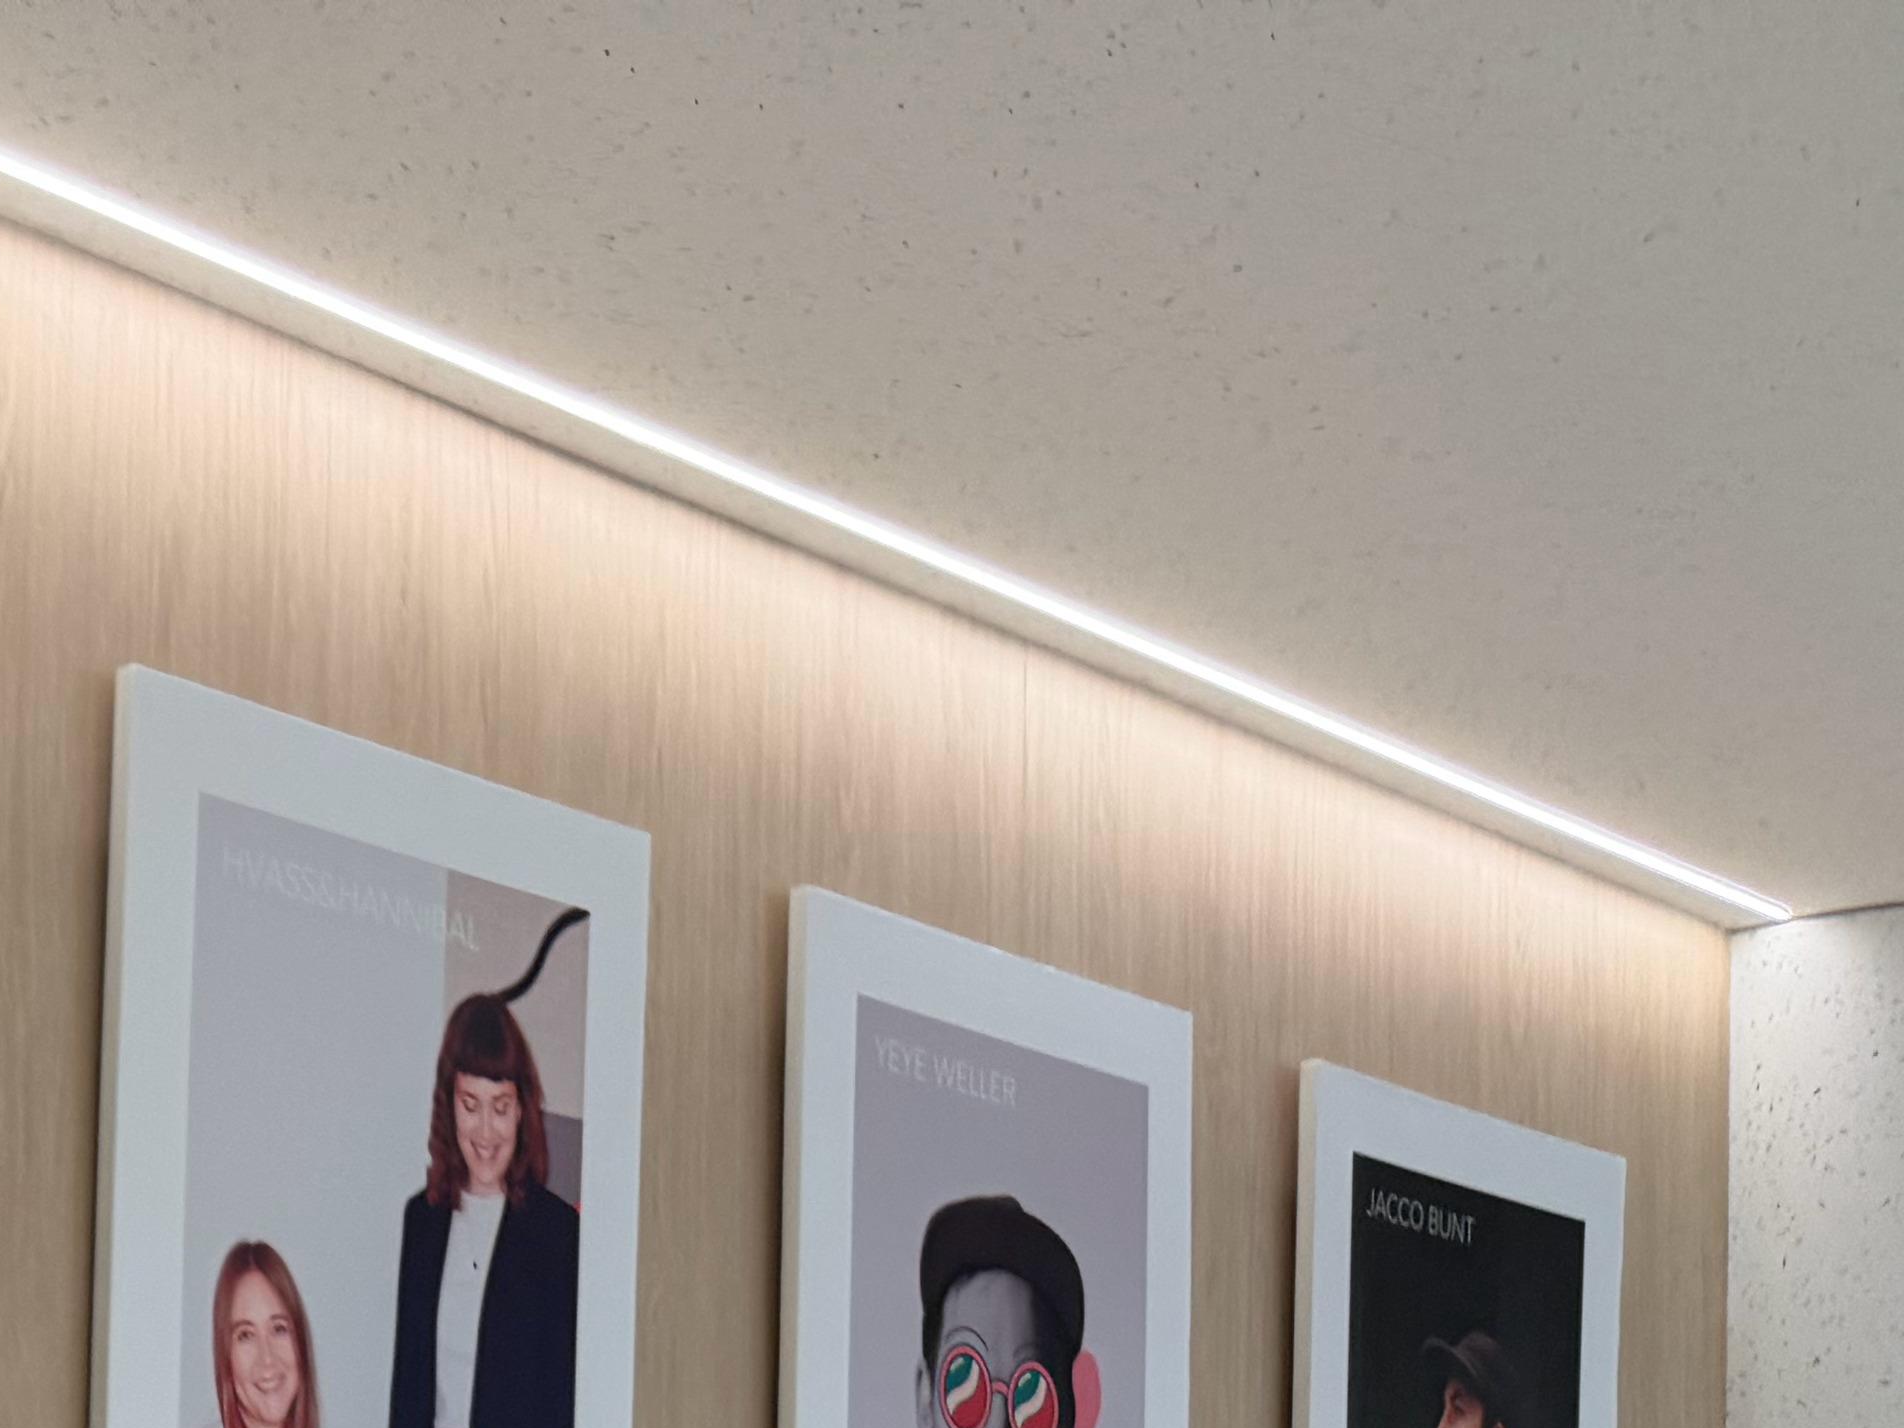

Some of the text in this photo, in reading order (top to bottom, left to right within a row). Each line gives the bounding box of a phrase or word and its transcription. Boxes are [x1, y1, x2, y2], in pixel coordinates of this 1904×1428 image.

[933, 1053, 1017, 1108] WELLER
[1366, 1187, 1476, 1245] JACCO BUNT
